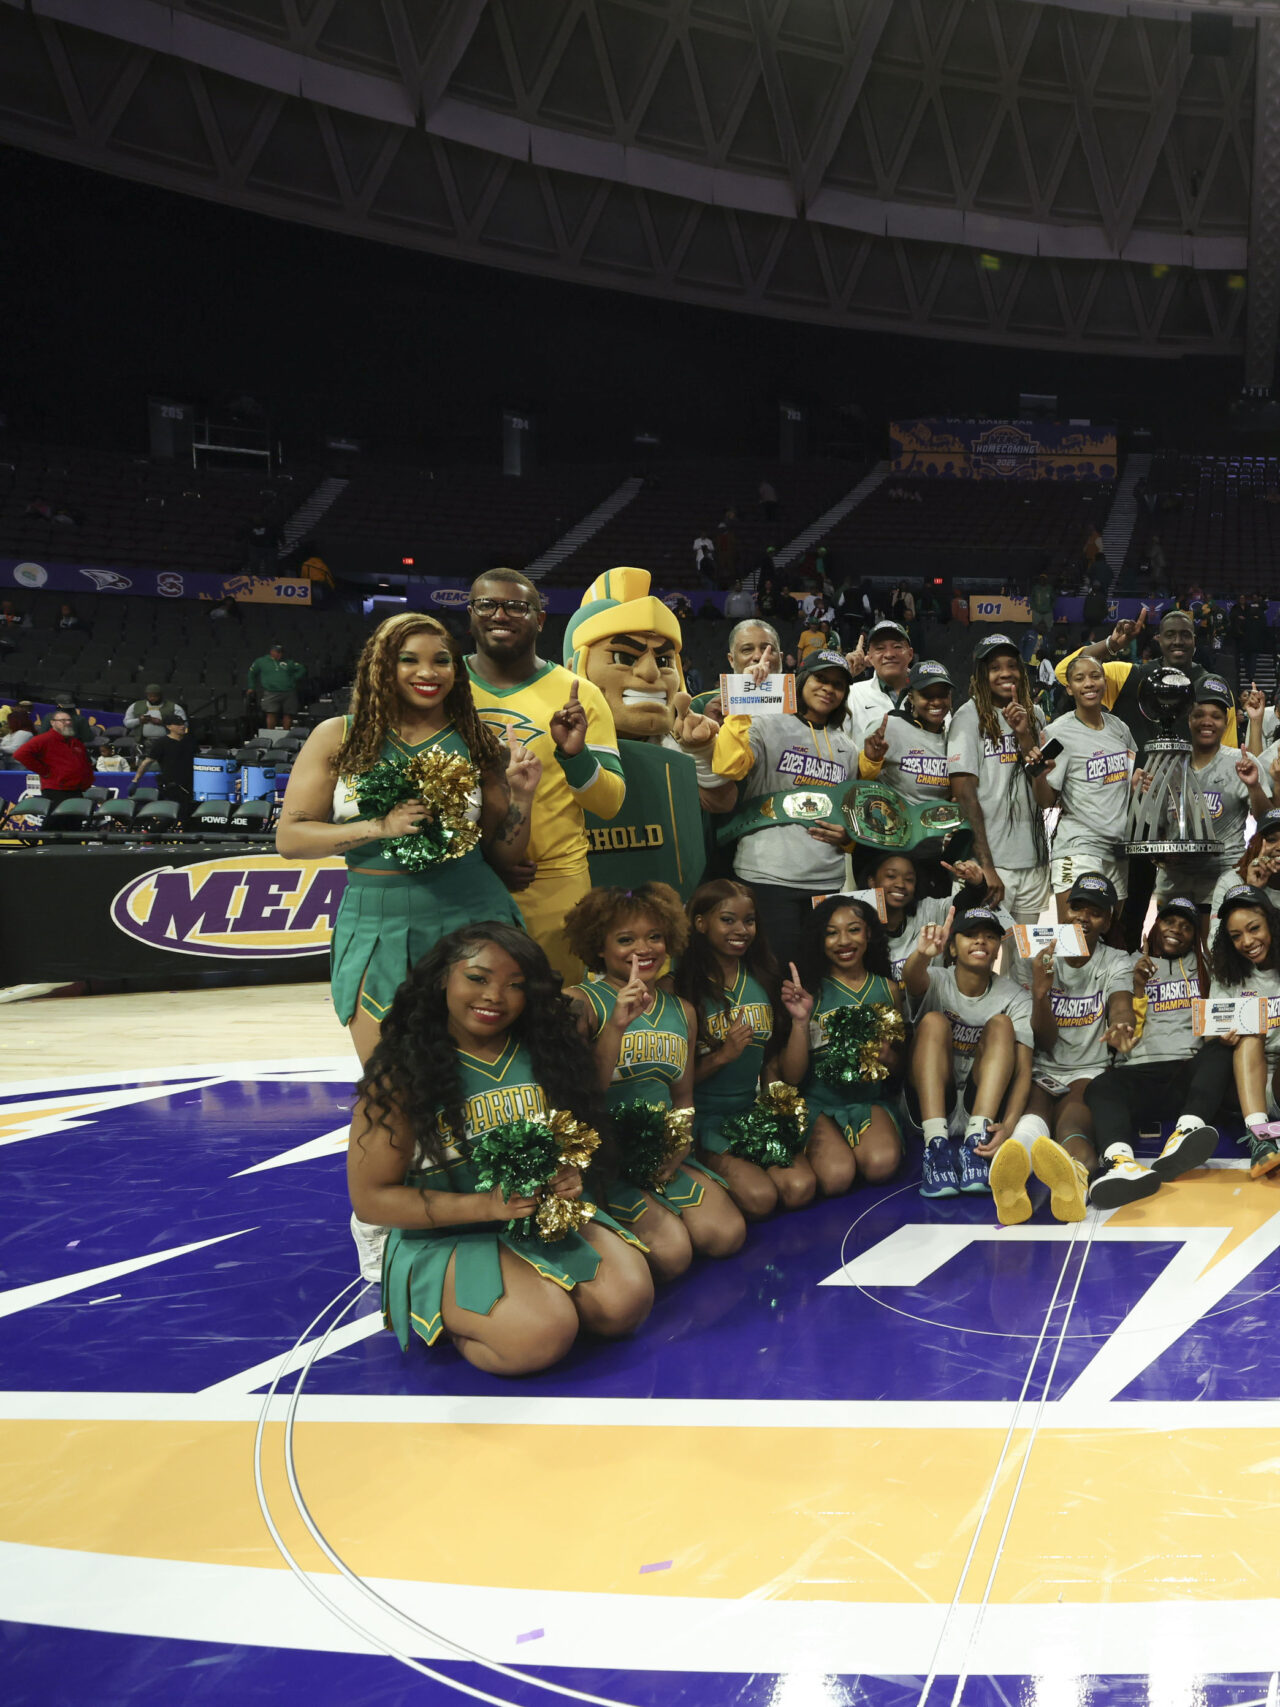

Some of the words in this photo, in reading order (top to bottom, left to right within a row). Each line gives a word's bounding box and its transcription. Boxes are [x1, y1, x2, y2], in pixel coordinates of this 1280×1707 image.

[977, 443, 1035, 455] HOMECOMING
[273, 584, 309, 599] 103
[435, 591, 469, 602] MEAC
[976, 602, 1002, 615] 101
[779, 752, 805, 774] 2025
[901, 758, 922, 773] 2025
[1087, 757, 1107, 779] 2025
[1147, 843, 1207, 853] TOURNAMENT
[147, 869, 348, 940] MEA
